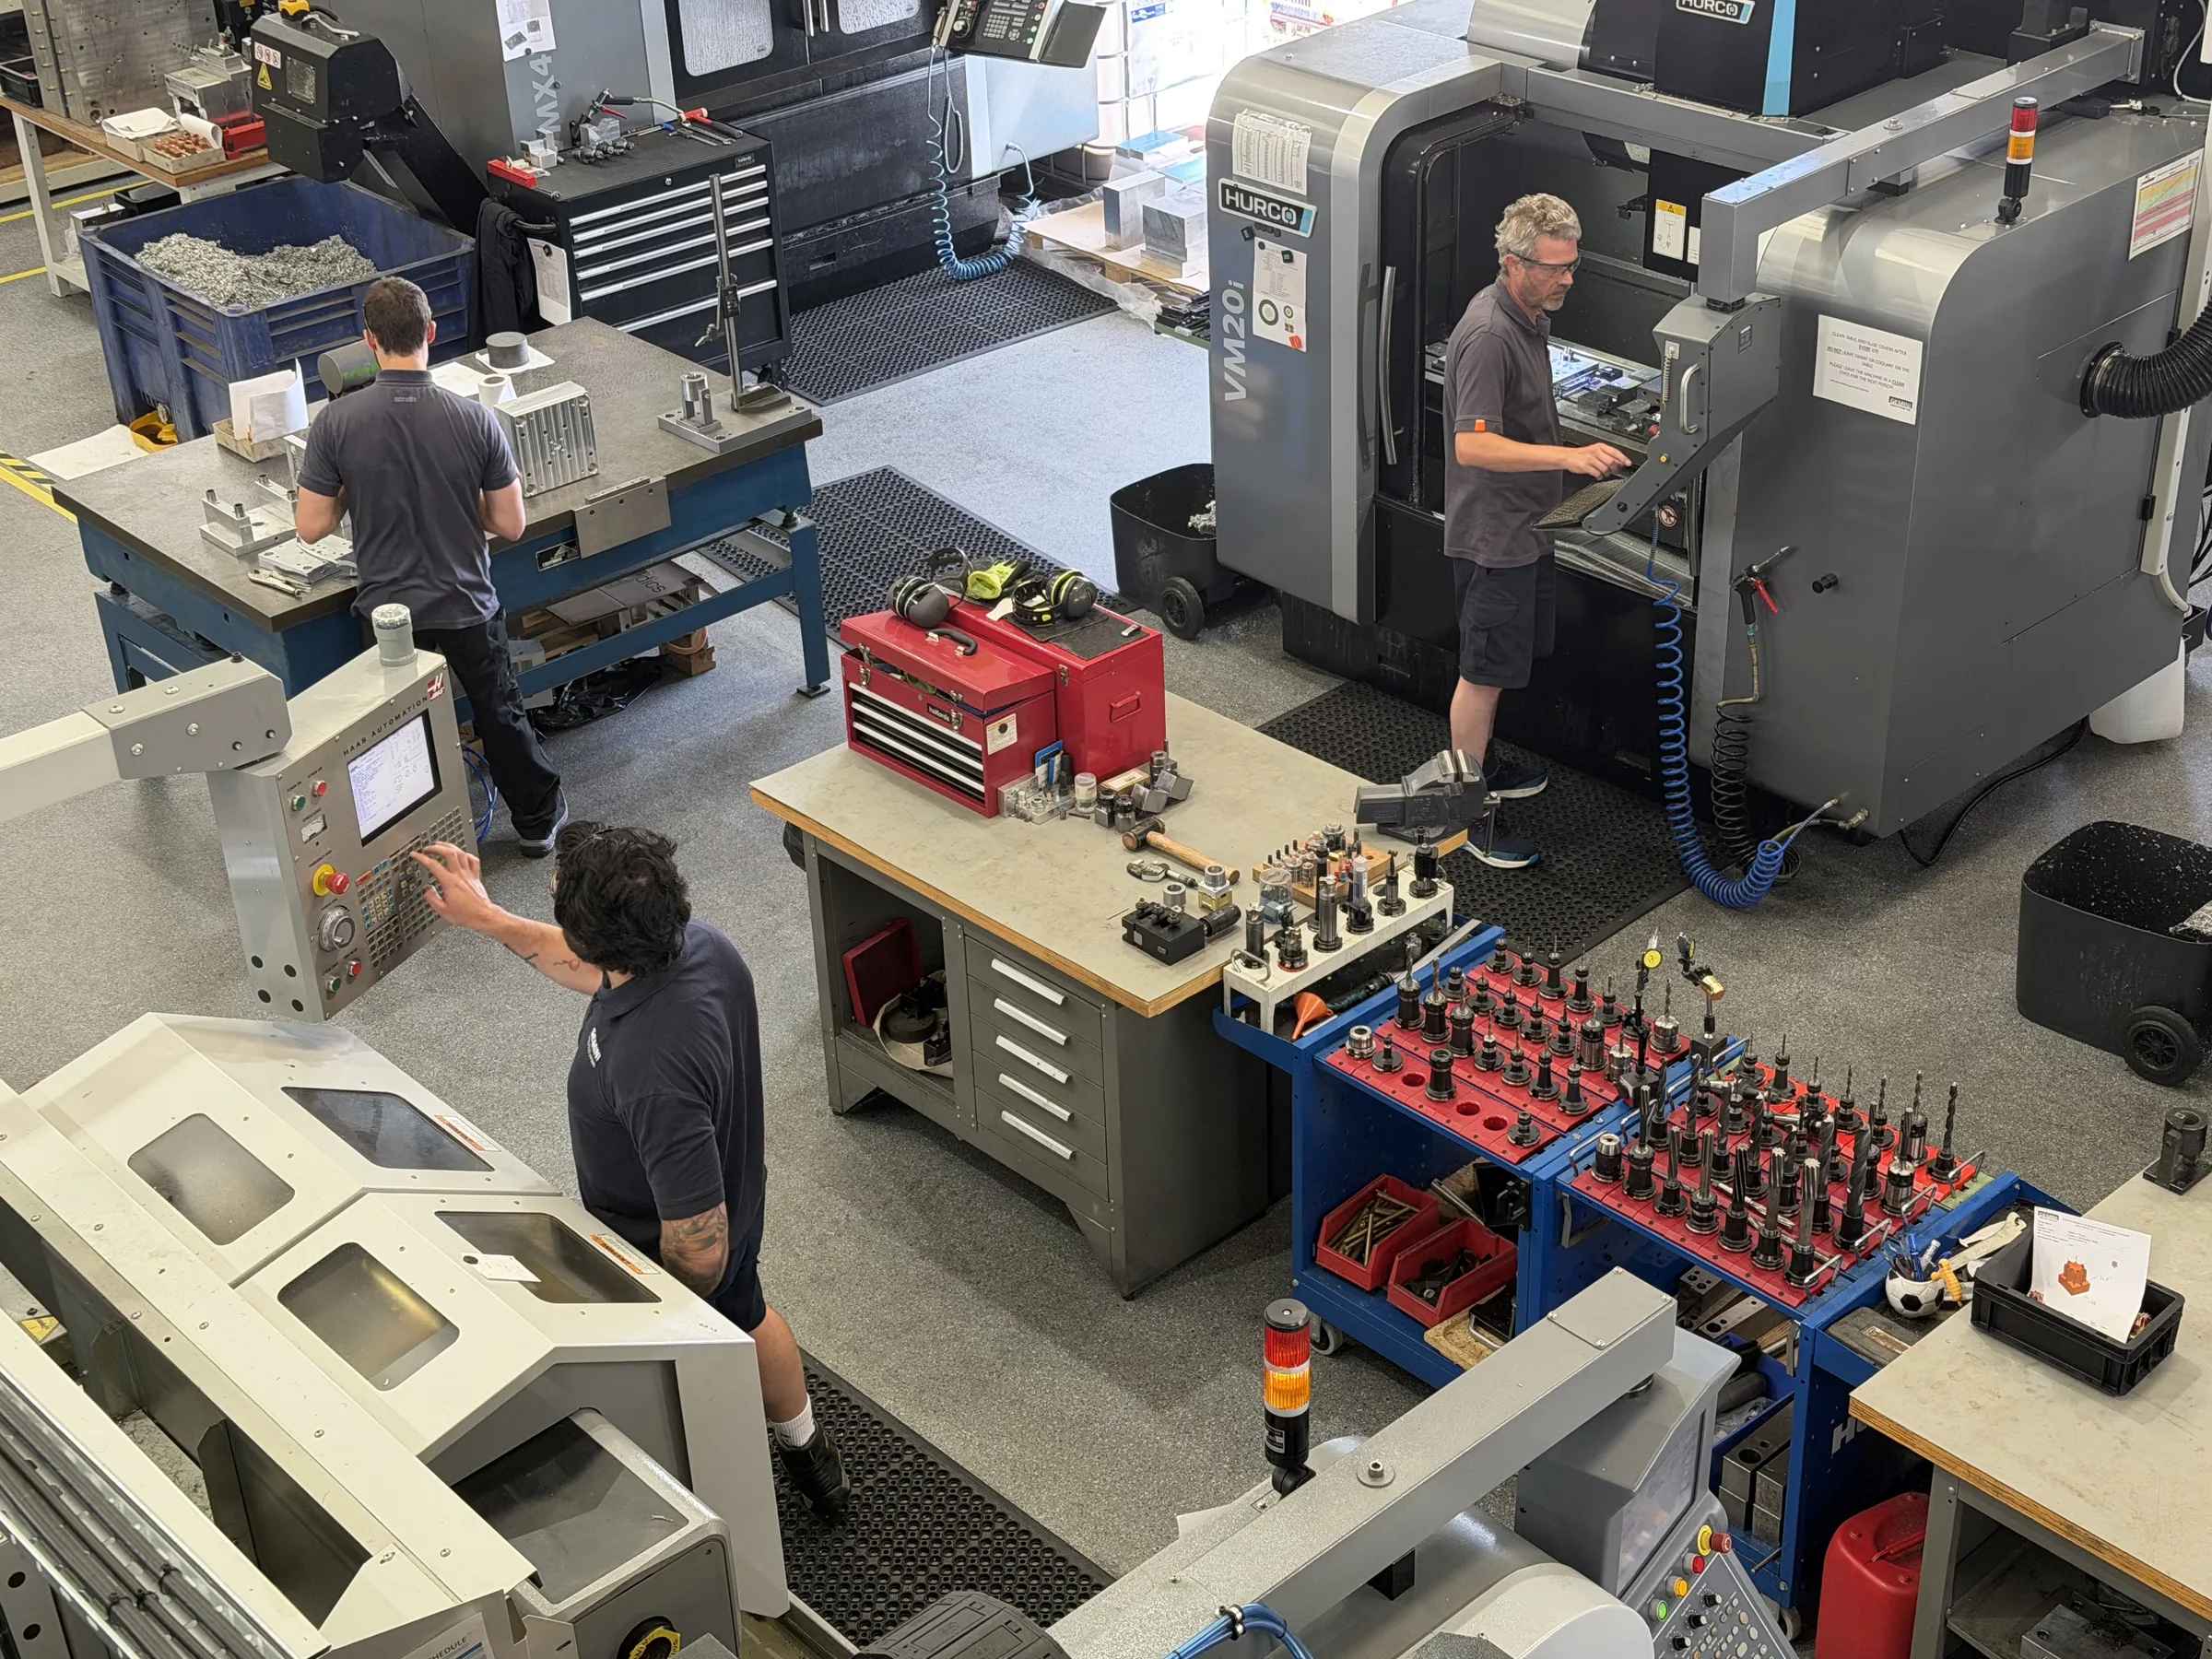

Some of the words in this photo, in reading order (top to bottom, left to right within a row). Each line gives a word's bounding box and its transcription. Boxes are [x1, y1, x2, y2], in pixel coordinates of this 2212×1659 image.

[1225, 188, 1297, 225] HURCO
[1221, 279, 1247, 402] VM20i
[343, 736, 367, 756] HAAS
[371, 697, 428, 737] AUTOMATION
